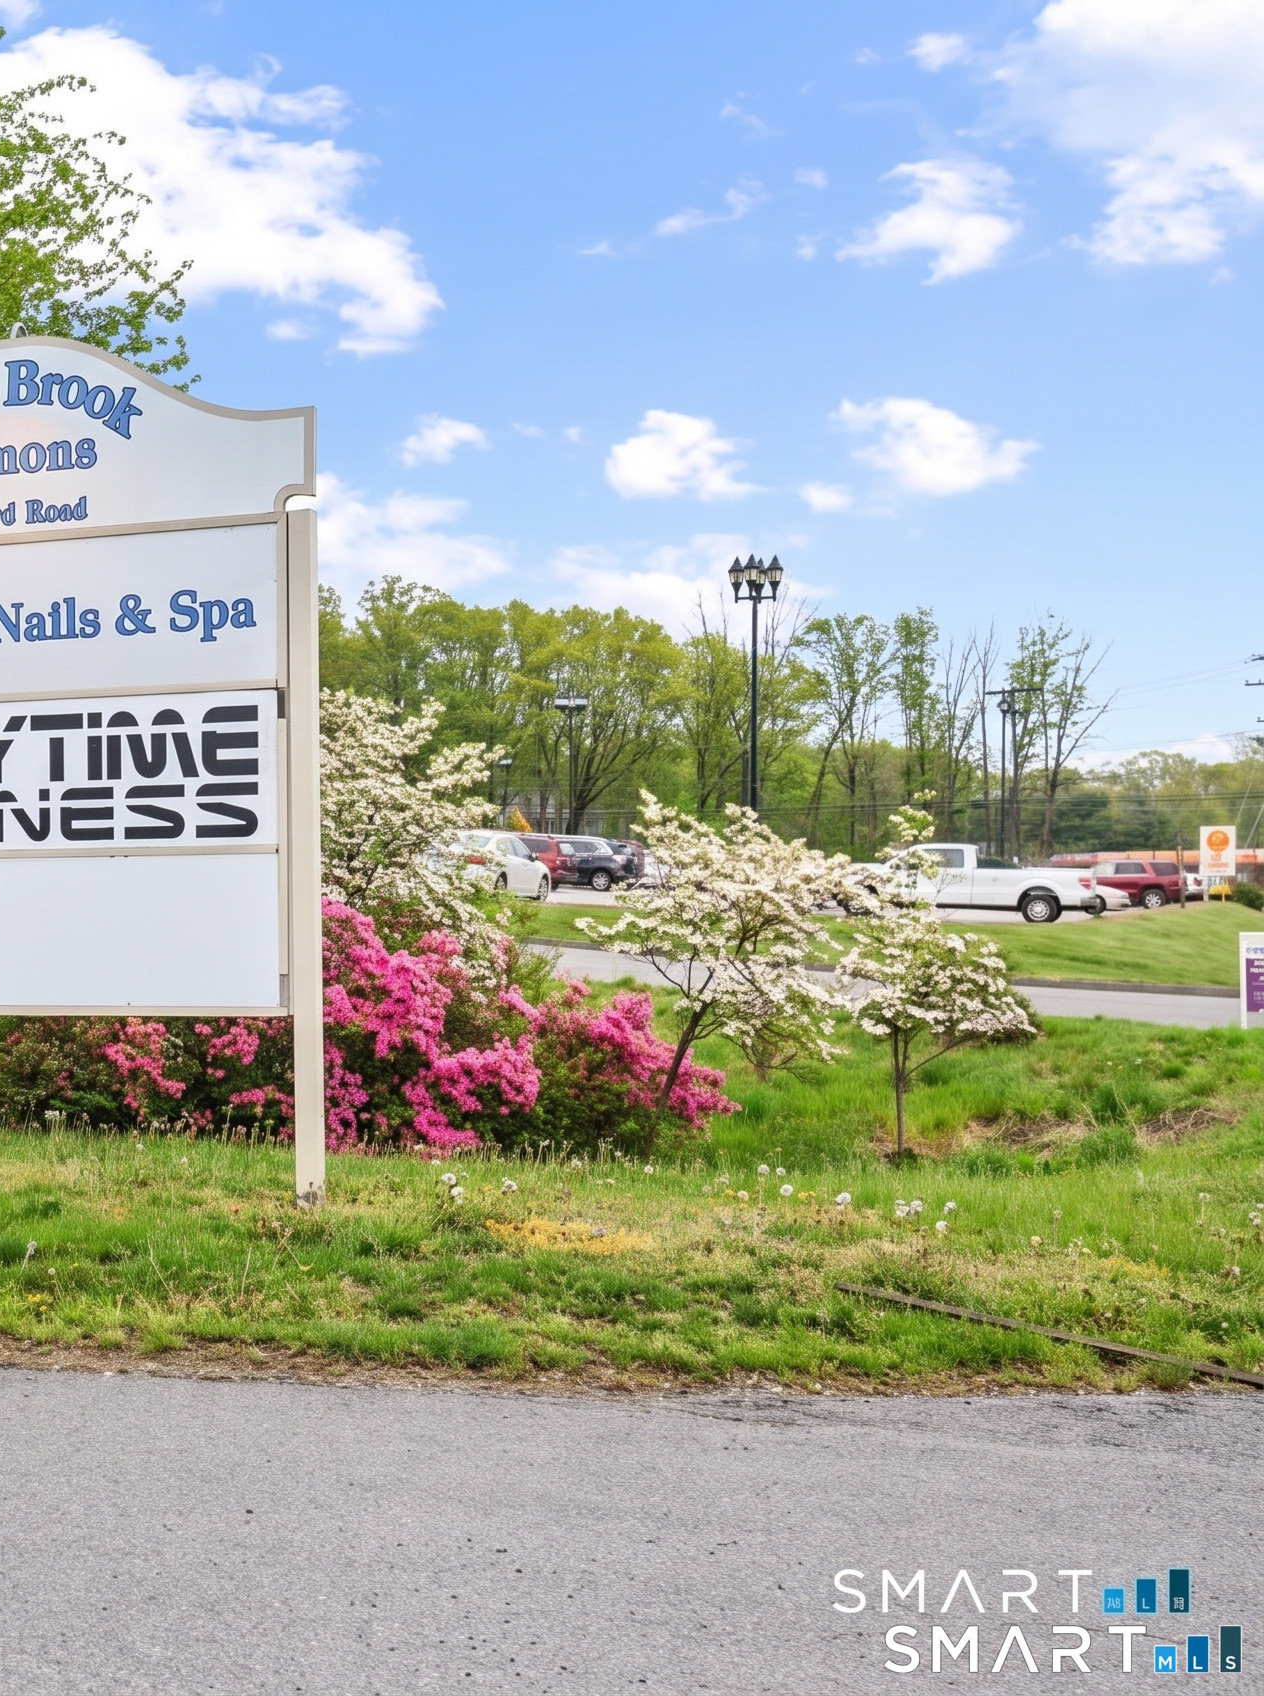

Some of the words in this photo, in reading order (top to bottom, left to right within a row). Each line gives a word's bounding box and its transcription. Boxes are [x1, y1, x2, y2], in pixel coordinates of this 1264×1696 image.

[4, 359, 143, 439] Brook
[25, 496, 89, 524] Road
[115, 594, 156, 636] &
[169, 589, 257, 643] Spa
